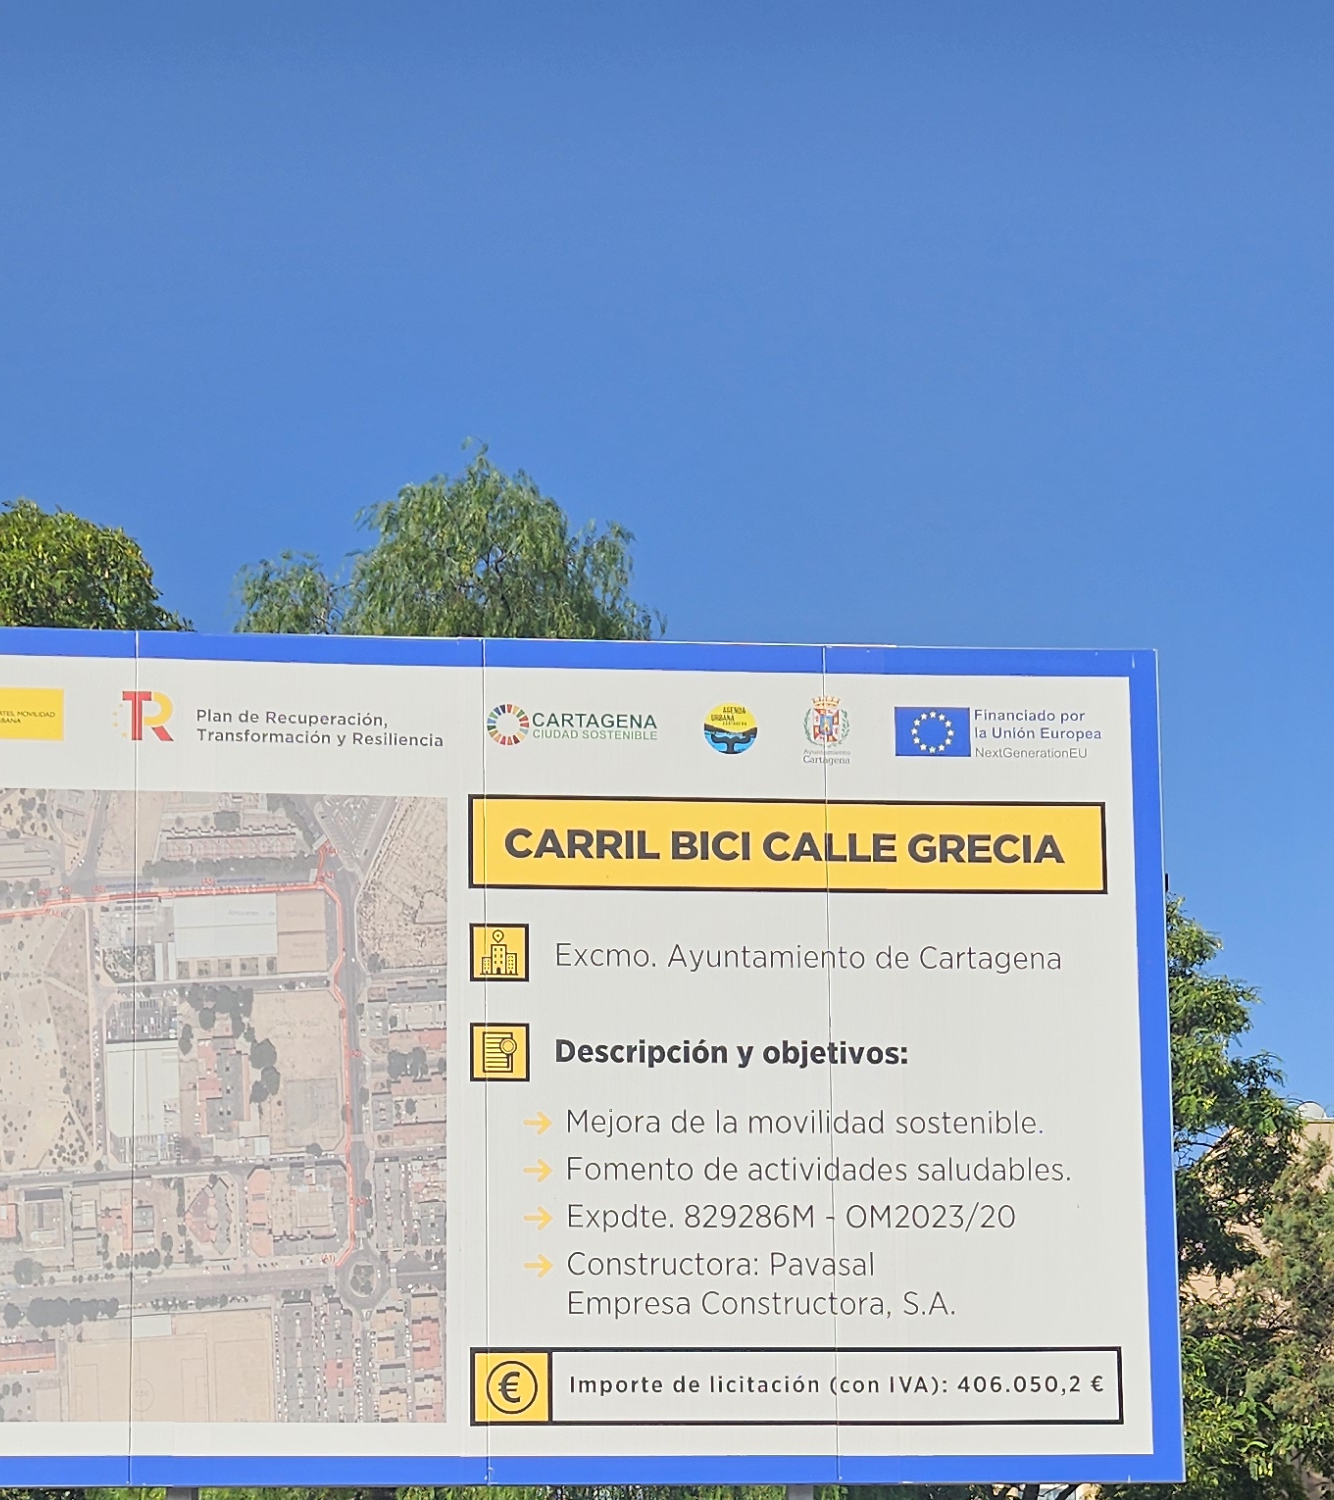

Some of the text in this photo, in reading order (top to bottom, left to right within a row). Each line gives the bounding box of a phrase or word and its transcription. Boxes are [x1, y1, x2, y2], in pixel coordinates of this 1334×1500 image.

[196, 708, 388, 728] Plan de Recuperación,
[532, 712, 658, 730] CARTAGENA
[974, 709, 1086, 727] Financiado por
[196, 727, 444, 749] Transformación y Resiliencia
[532, 729, 658, 741] CIUDAD SOSTENIBLE
[974, 727, 1102, 742] la Unión Europea
[802, 756, 850, 766] Cartagena
[975, 747, 1088, 759] NextGenerationEU
[504, 827, 1066, 864] CARRIL BICI CALLE GRECIA
[556, 942, 1061, 975] Excmo. Ayuntamiento de Cartagena
[555, 1038, 908, 1070] Descripción y objetivos:
[567, 1108, 1044, 1138] Mejora de la movilidad sostenible.
[567, 1156, 1071, 1183] Fomento de actividades saludables.
[568, 1203, 674, 1233] Expdte.
[684, 1204, 814, 1229] 829286M
[845, 1201, 1016, 1233] OM2023/20
[567, 1251, 875, 1277] Constructora: Pavasal
[568, 1290, 955, 1321] Empresa Constructora, S.A.
[570, 1374, 1104, 1397] Importe de licitación (con IVA): 406.050,2 €
